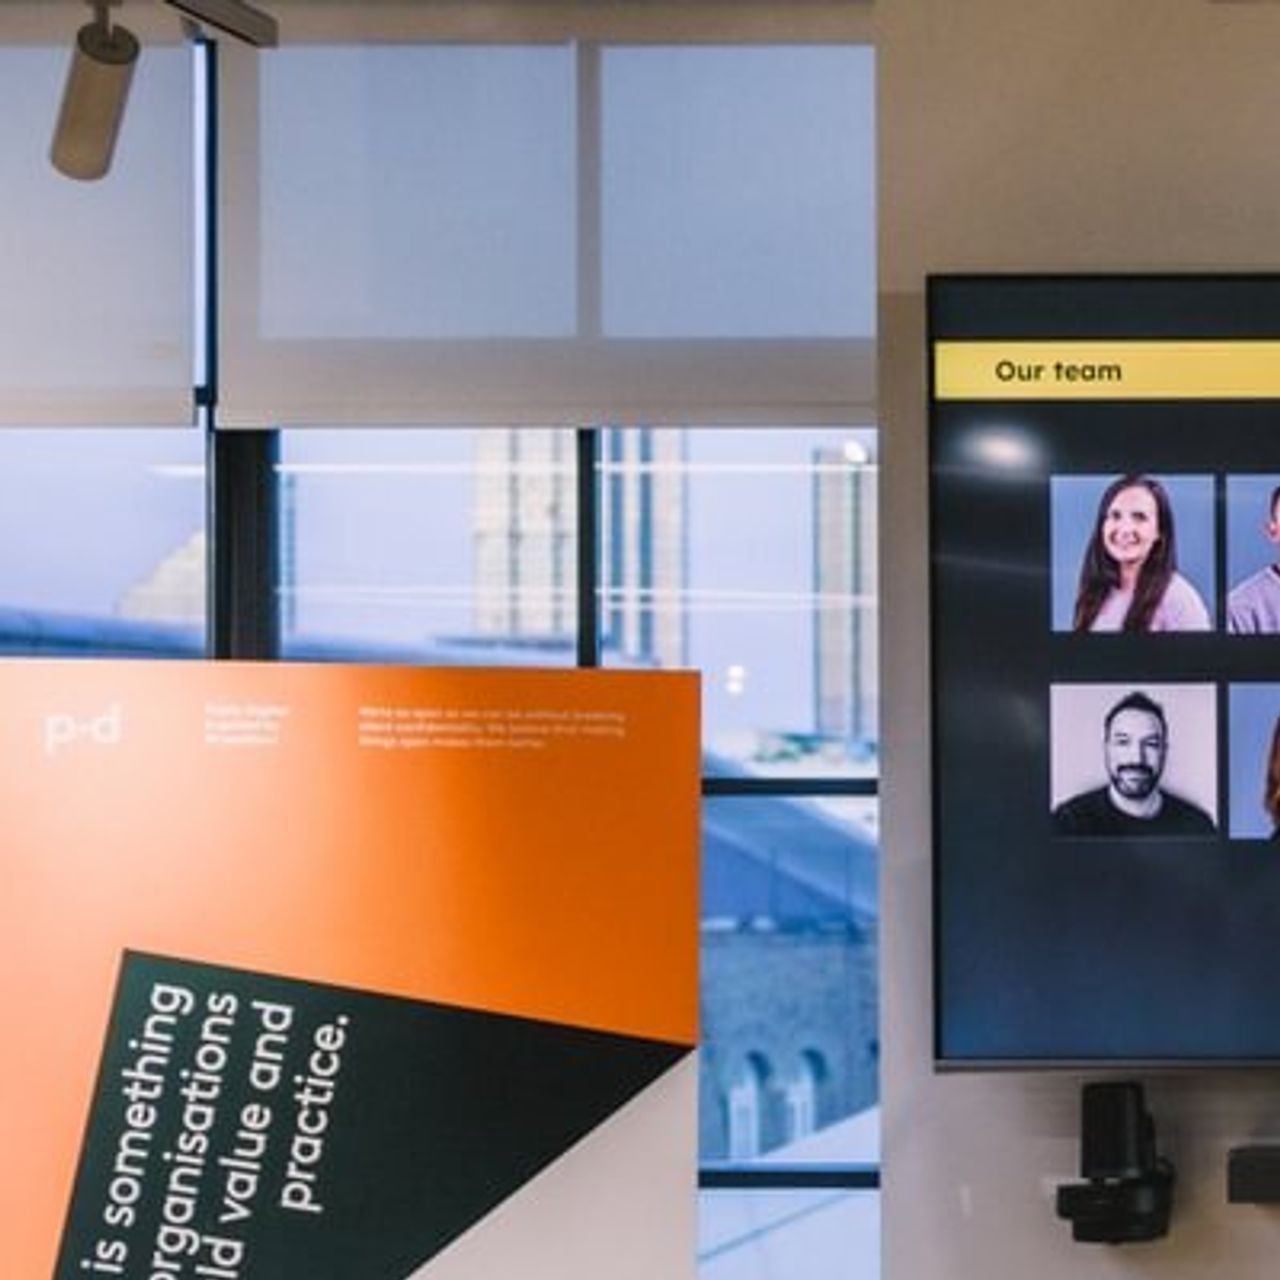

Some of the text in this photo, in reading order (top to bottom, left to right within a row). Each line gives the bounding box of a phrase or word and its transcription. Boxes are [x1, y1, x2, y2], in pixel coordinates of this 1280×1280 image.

[995, 360, 1121, 381] Our team
[103, 982, 194, 1227] something
[218, 1102, 271, 1224] value
[249, 1000, 293, 1090] and
[280, 1014, 350, 1213] practice.
[80, 1239, 128, 1274] is
